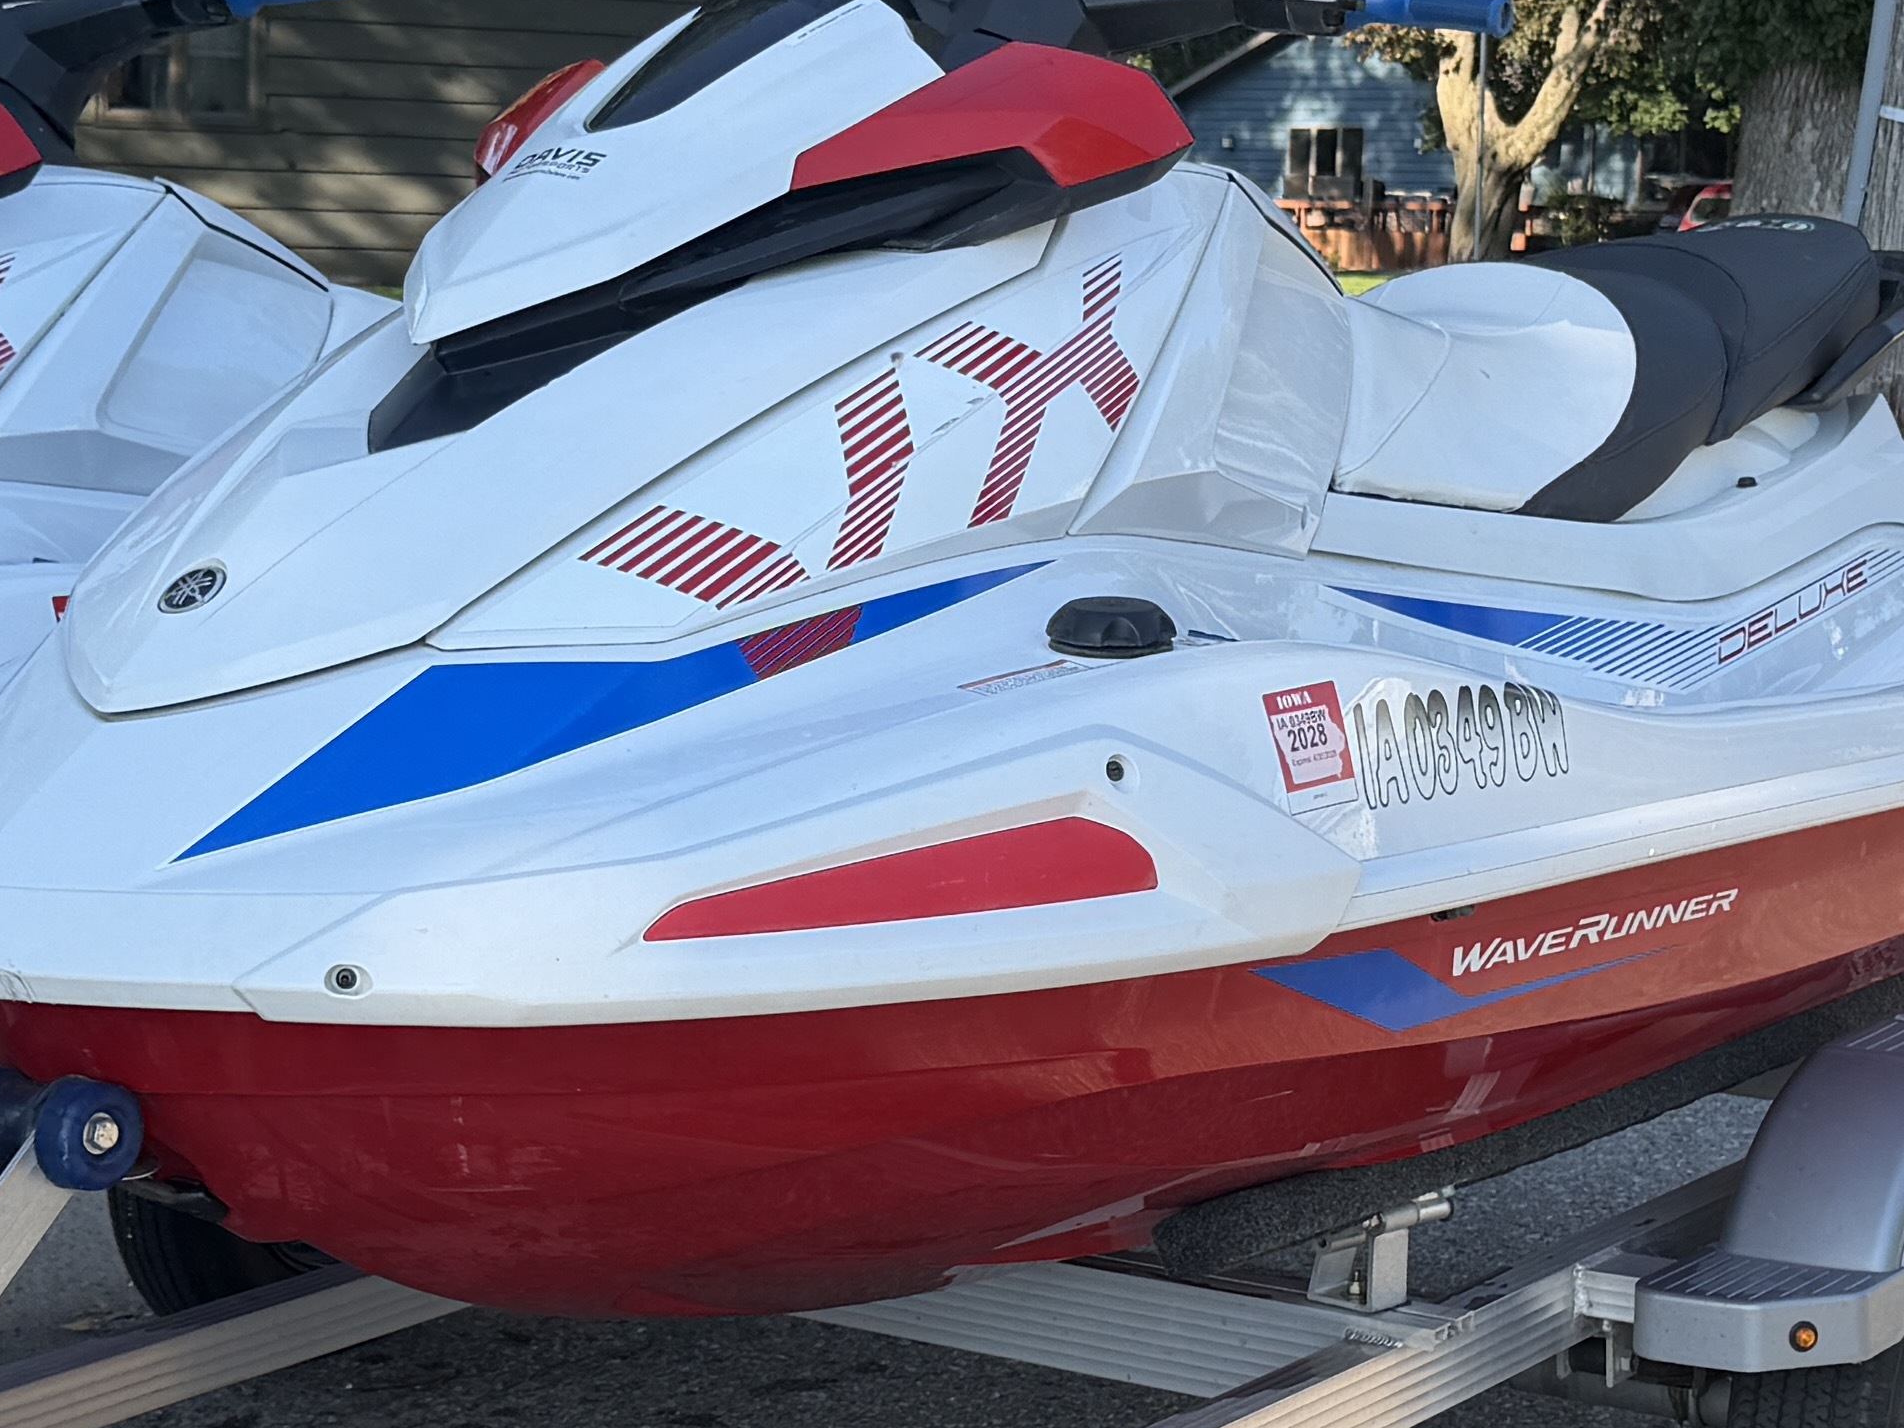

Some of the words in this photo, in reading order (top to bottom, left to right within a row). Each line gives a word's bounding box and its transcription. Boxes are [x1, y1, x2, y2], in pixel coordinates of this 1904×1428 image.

[514, 147, 607, 170] DAVIS
[1717, 559, 1868, 665] DELUXE
[1276, 691, 1312, 710] IOWA
[1287, 723, 1328, 752] 2028
